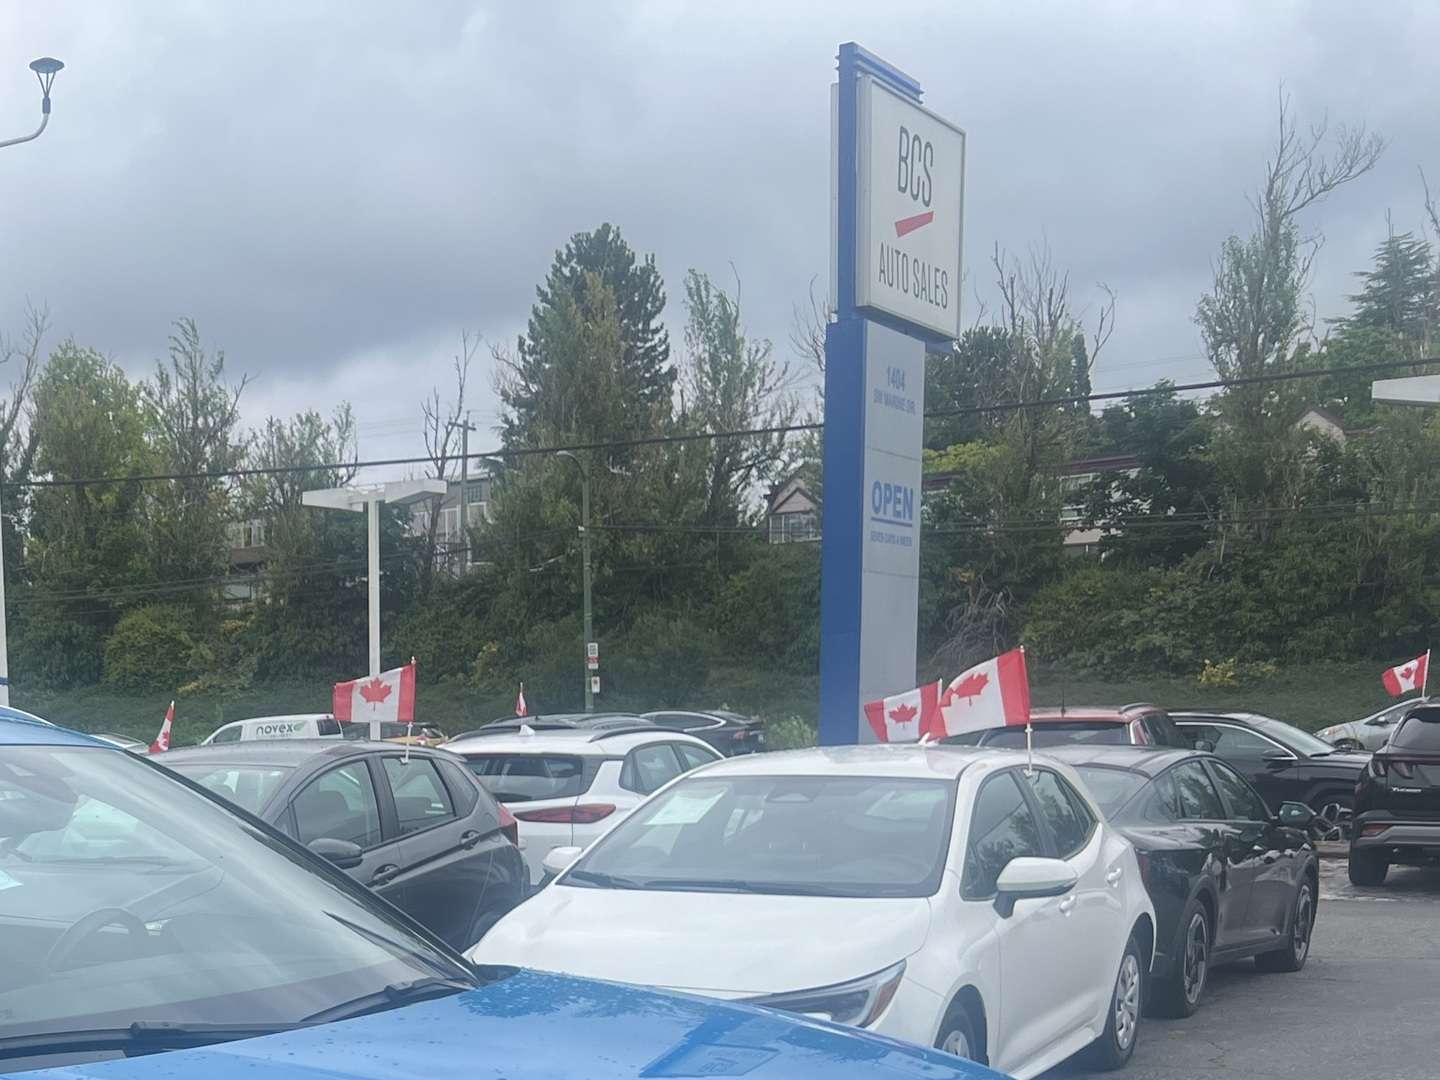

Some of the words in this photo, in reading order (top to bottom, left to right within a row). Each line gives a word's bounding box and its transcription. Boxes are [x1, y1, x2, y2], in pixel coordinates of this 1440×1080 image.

[897, 125, 934, 208] BCS
[878, 241, 909, 295] AUTO
[913, 258, 948, 309] SALES
[871, 480, 914, 521] OPEN
[256, 723, 293, 735] novex
